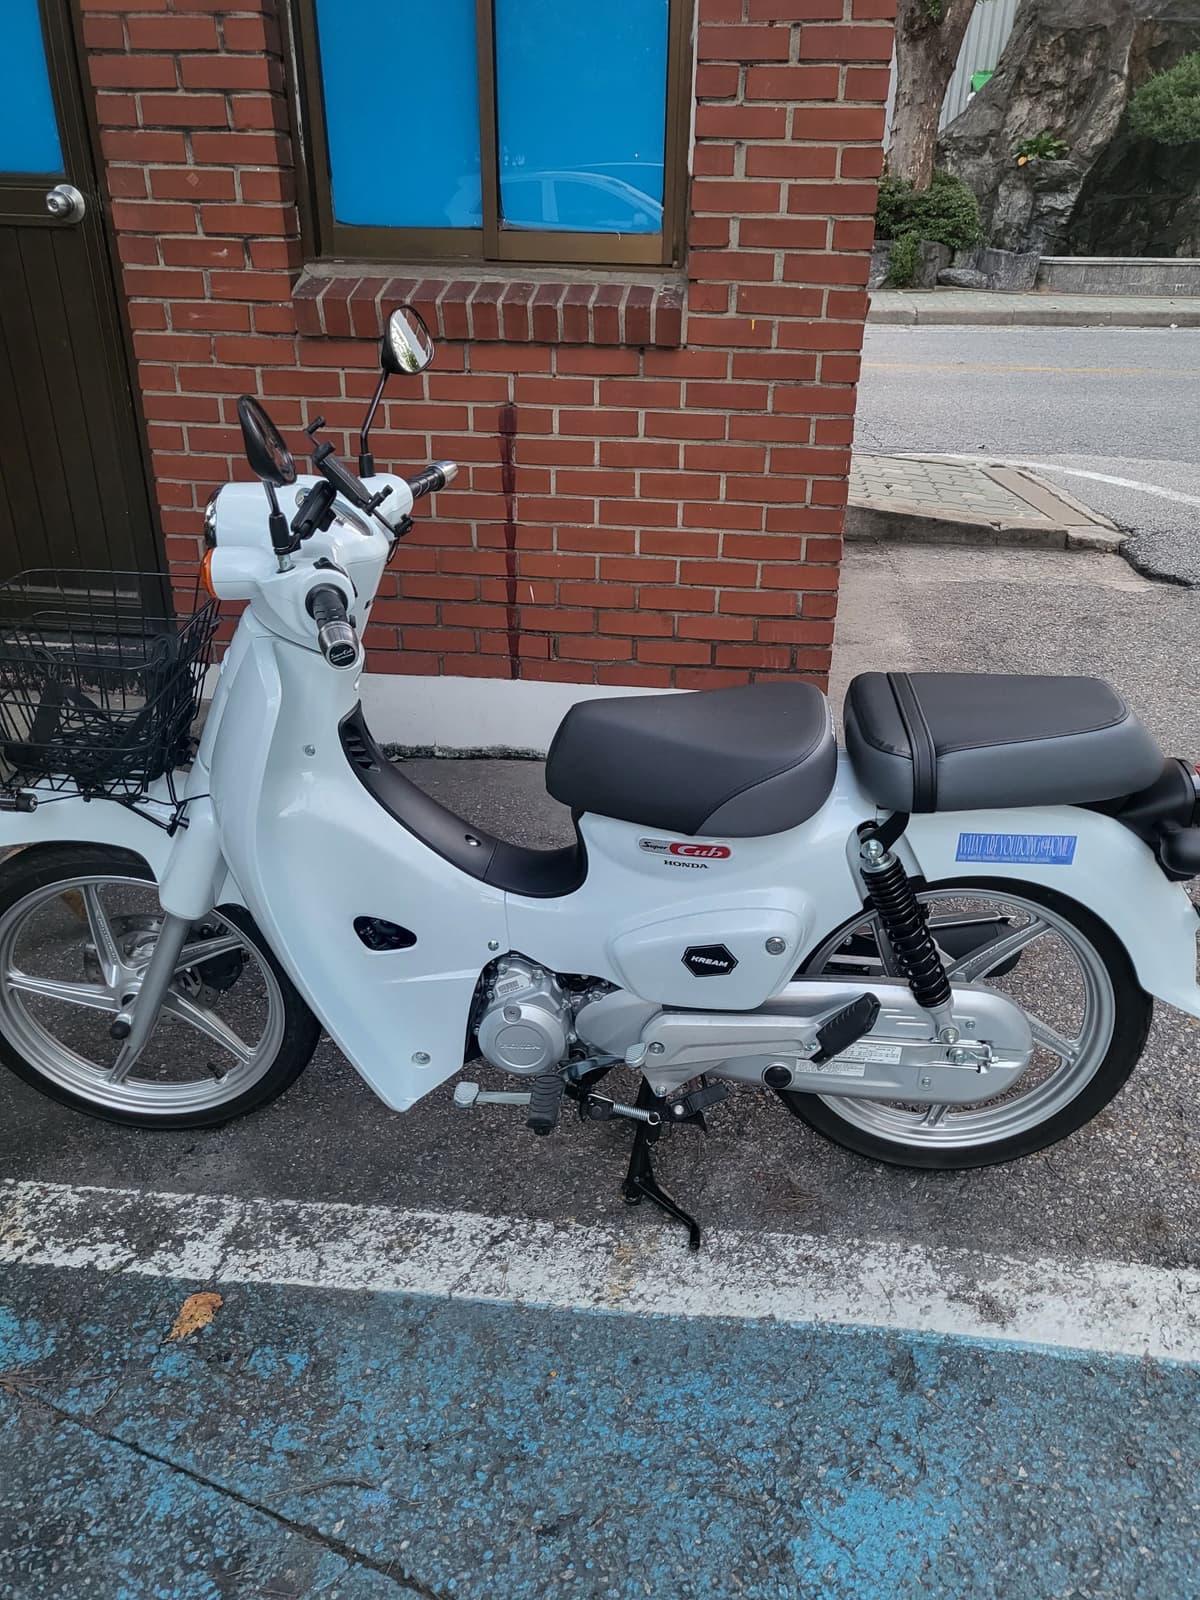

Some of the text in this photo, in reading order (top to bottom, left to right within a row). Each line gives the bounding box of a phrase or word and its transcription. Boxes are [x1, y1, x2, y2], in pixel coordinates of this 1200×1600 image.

[641, 841, 723, 857] Super Cub
[664, 860, 708, 869] HONDA
[691, 955, 728, 967] KREAM
